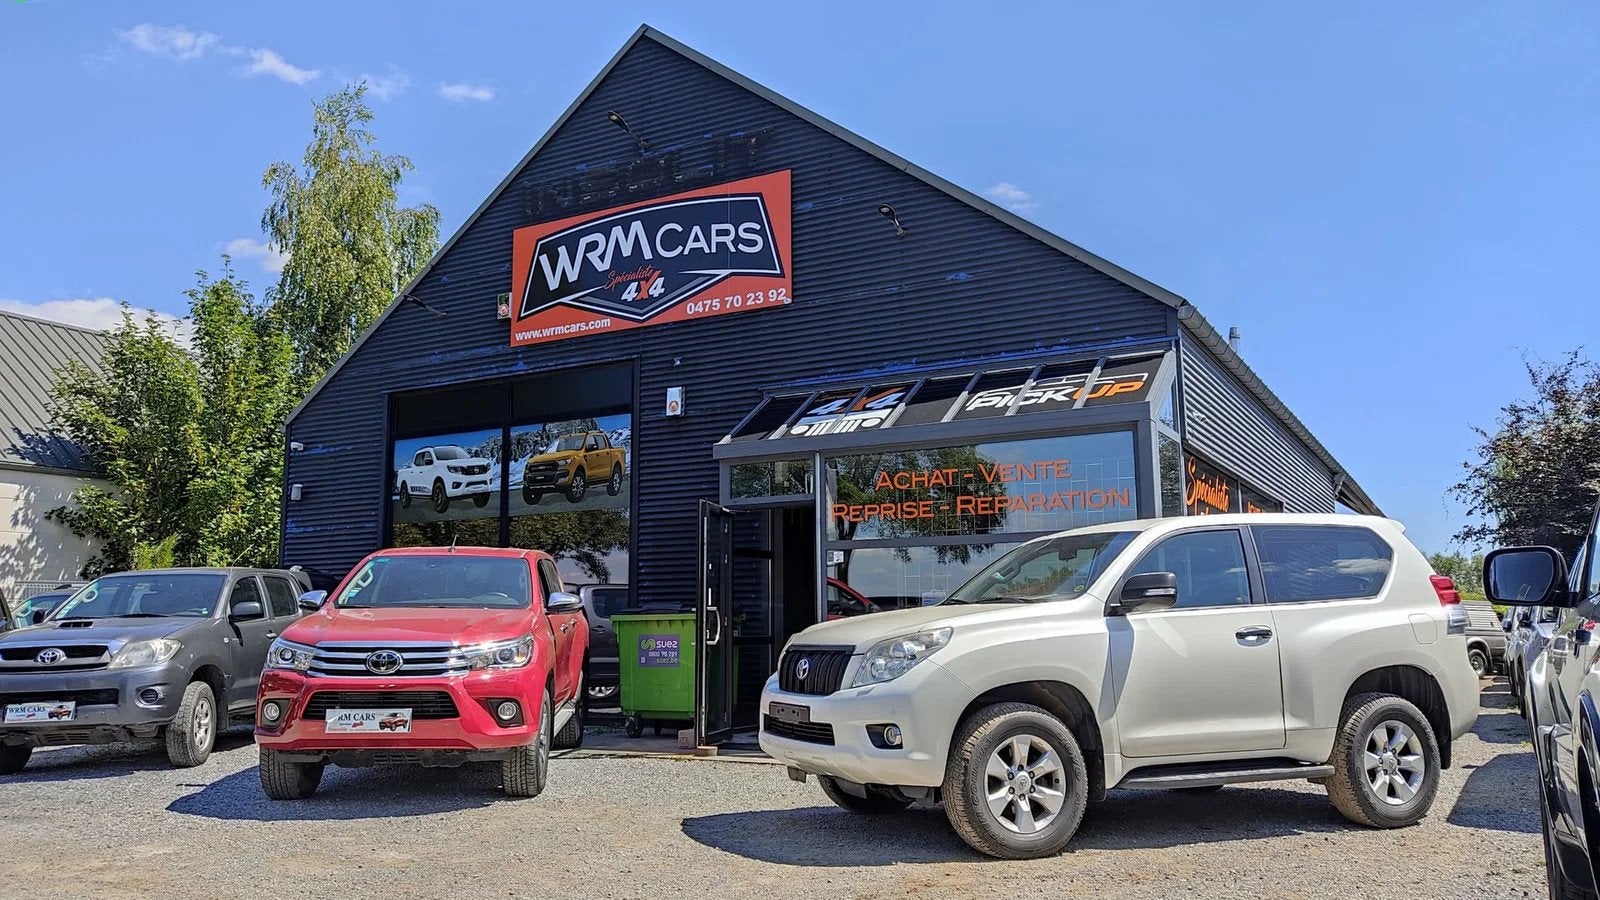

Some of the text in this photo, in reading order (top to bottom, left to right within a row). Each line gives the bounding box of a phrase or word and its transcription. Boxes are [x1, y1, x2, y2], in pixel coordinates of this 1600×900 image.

[539, 220, 764, 291] WRM CARS
[687, 288, 786, 315] 0475 70 23 92
[515, 317, 611, 341] www.wrmcars.com
[875, 468, 959, 491] ACHAT
[978, 460, 1071, 483] VENTE
[831, 501, 935, 523] REPRISE
[956, 488, 1131, 516] REPARATION
[353, 713, 376, 721] CARS
